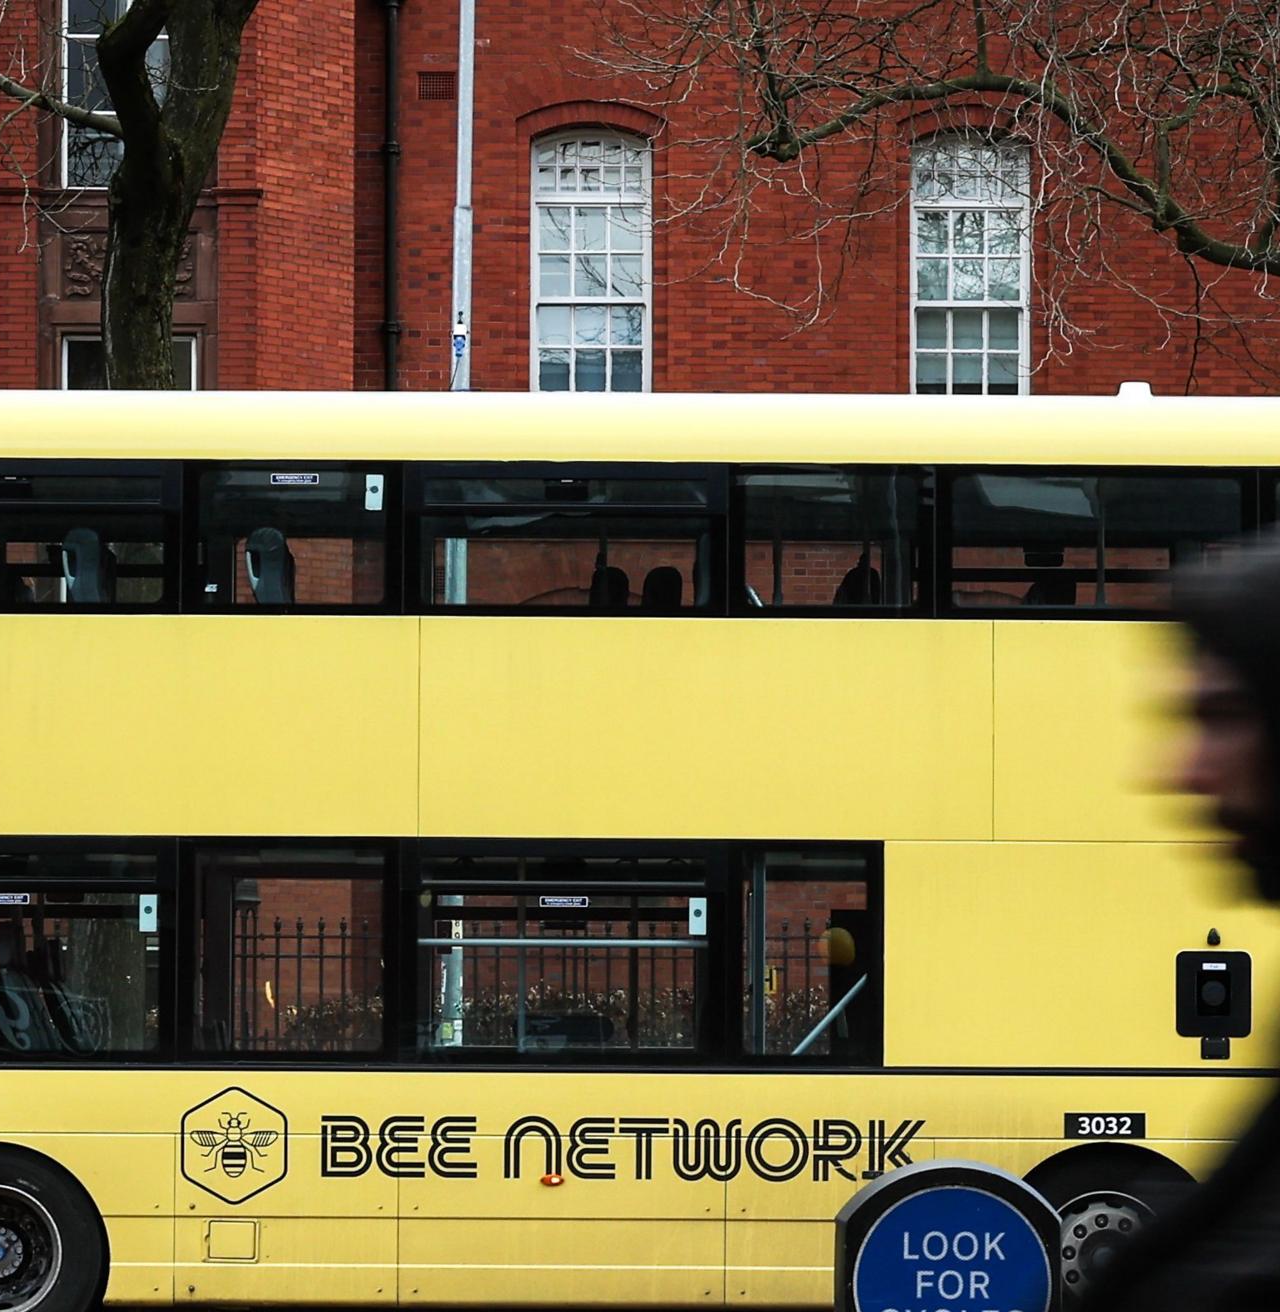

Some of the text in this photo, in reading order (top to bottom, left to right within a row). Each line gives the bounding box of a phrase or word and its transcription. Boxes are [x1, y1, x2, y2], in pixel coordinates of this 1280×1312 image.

[1078, 1116, 1132, 1135] 3032
[320, 1115, 927, 1183] BEE NETWORK
[904, 1231, 1005, 1261] LOOK
[916, 1270, 990, 1300] FOR
